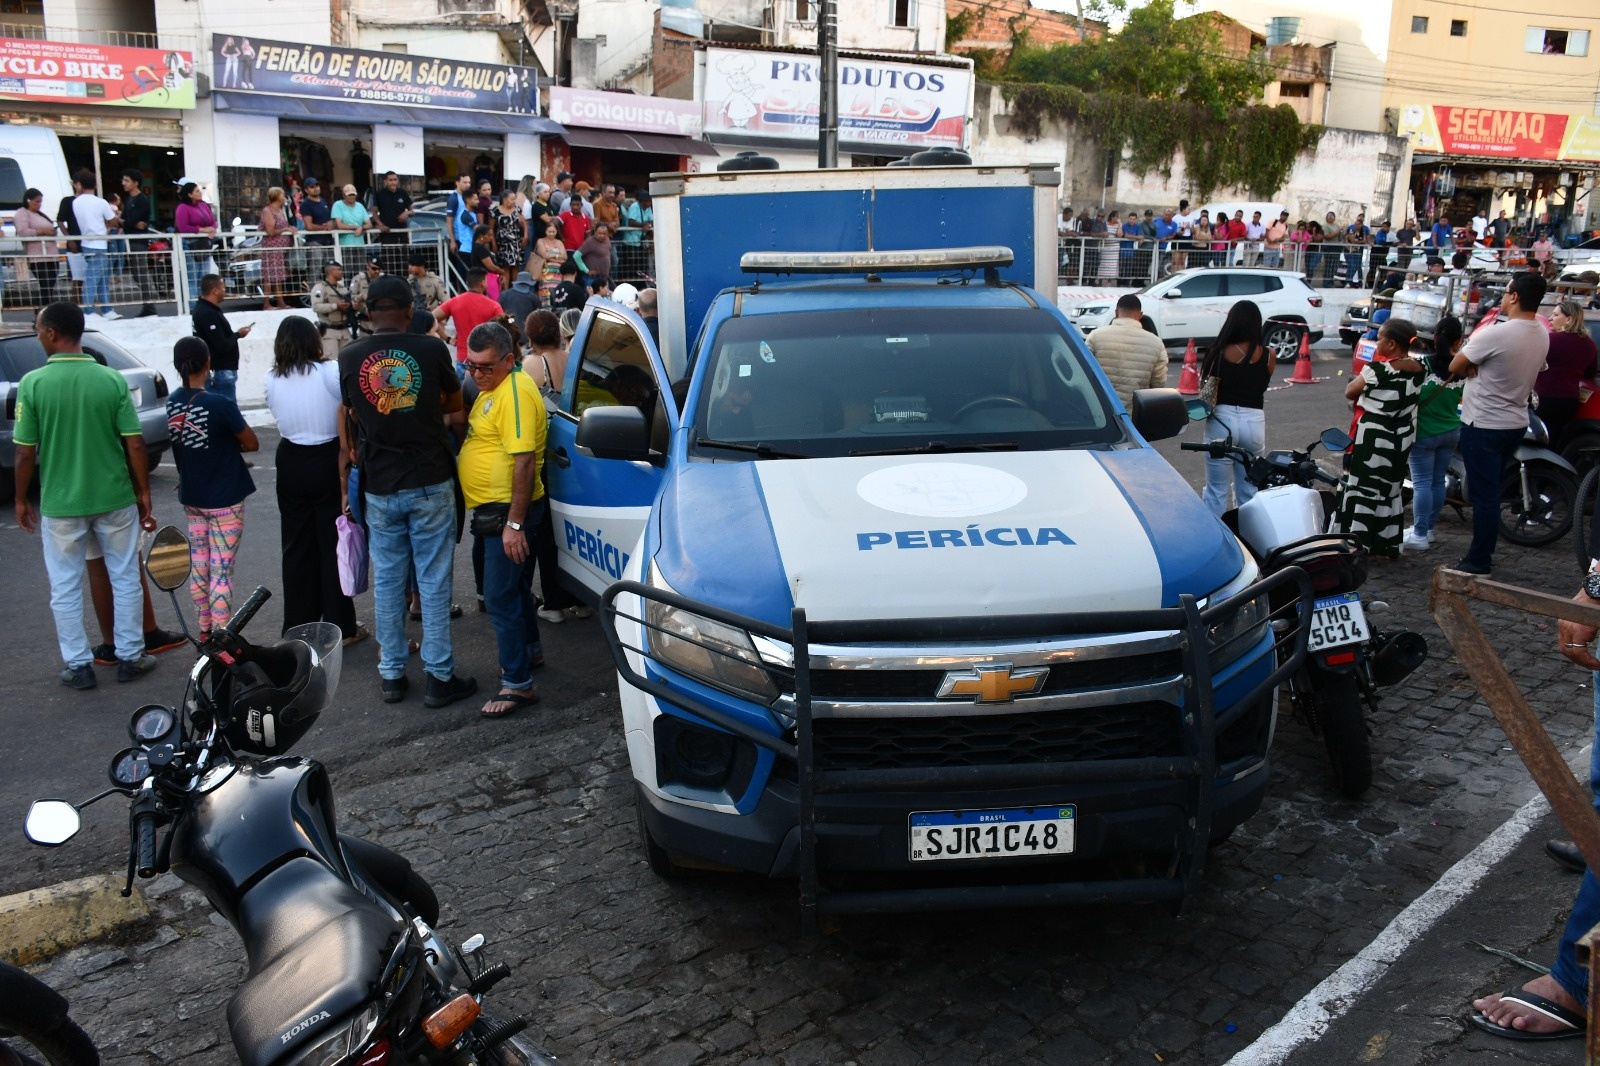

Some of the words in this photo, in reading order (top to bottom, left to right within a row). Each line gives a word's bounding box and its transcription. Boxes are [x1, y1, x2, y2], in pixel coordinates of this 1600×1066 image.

[63, 60, 124, 80] BIKE
[255, 45, 325, 74] FEIRÃO
[327, 53, 354, 77] DE
[355, 55, 413, 83] ROUPA
[416, 59, 452, 87] SÃO
[453, 66, 506, 92] PAULO
[771, 60, 945, 92] PRDUTOS
[343, 87, 357, 98] 77
[571, 101, 677, 126] CONQUISTA
[1447, 107, 1546, 144] SECMAQ
[863, 129, 909, 140] VAREJO
[856, 523, 1077, 551] PERÍCIA
[1313, 605, 1352, 626] TMQ
[1316, 599, 1341, 609] BRASIL
[1311, 621, 1362, 647] 5C14
[979, 814, 1007, 822] BRASIL
[926, 823, 1058, 856] SJR1C48
[913, 849, 923, 859] BR
[281, 1010, 331, 1044] HONDA
